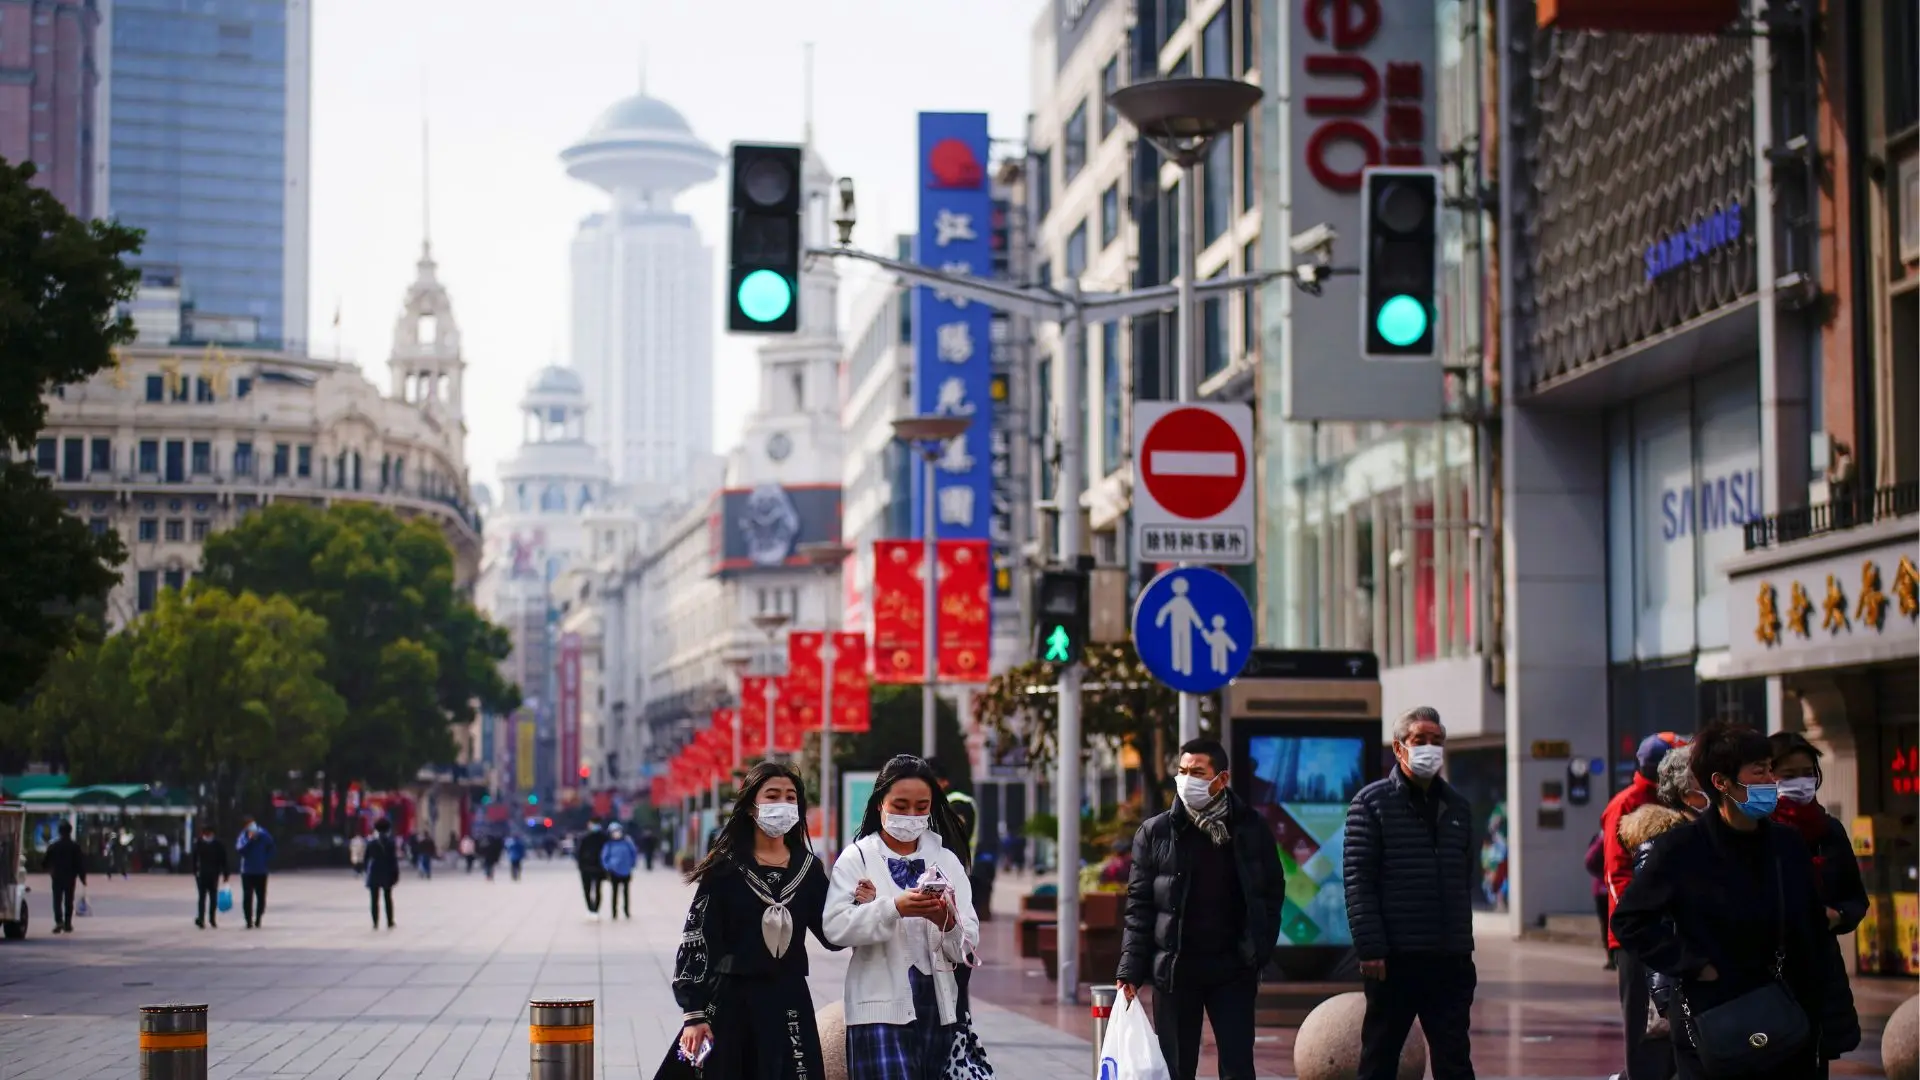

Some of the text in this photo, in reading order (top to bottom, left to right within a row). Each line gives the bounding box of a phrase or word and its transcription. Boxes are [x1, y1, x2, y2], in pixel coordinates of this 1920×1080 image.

[1644, 202, 1742, 281] SAMSUNG
[1147, 531, 1241, 553] 除特种车辆外
